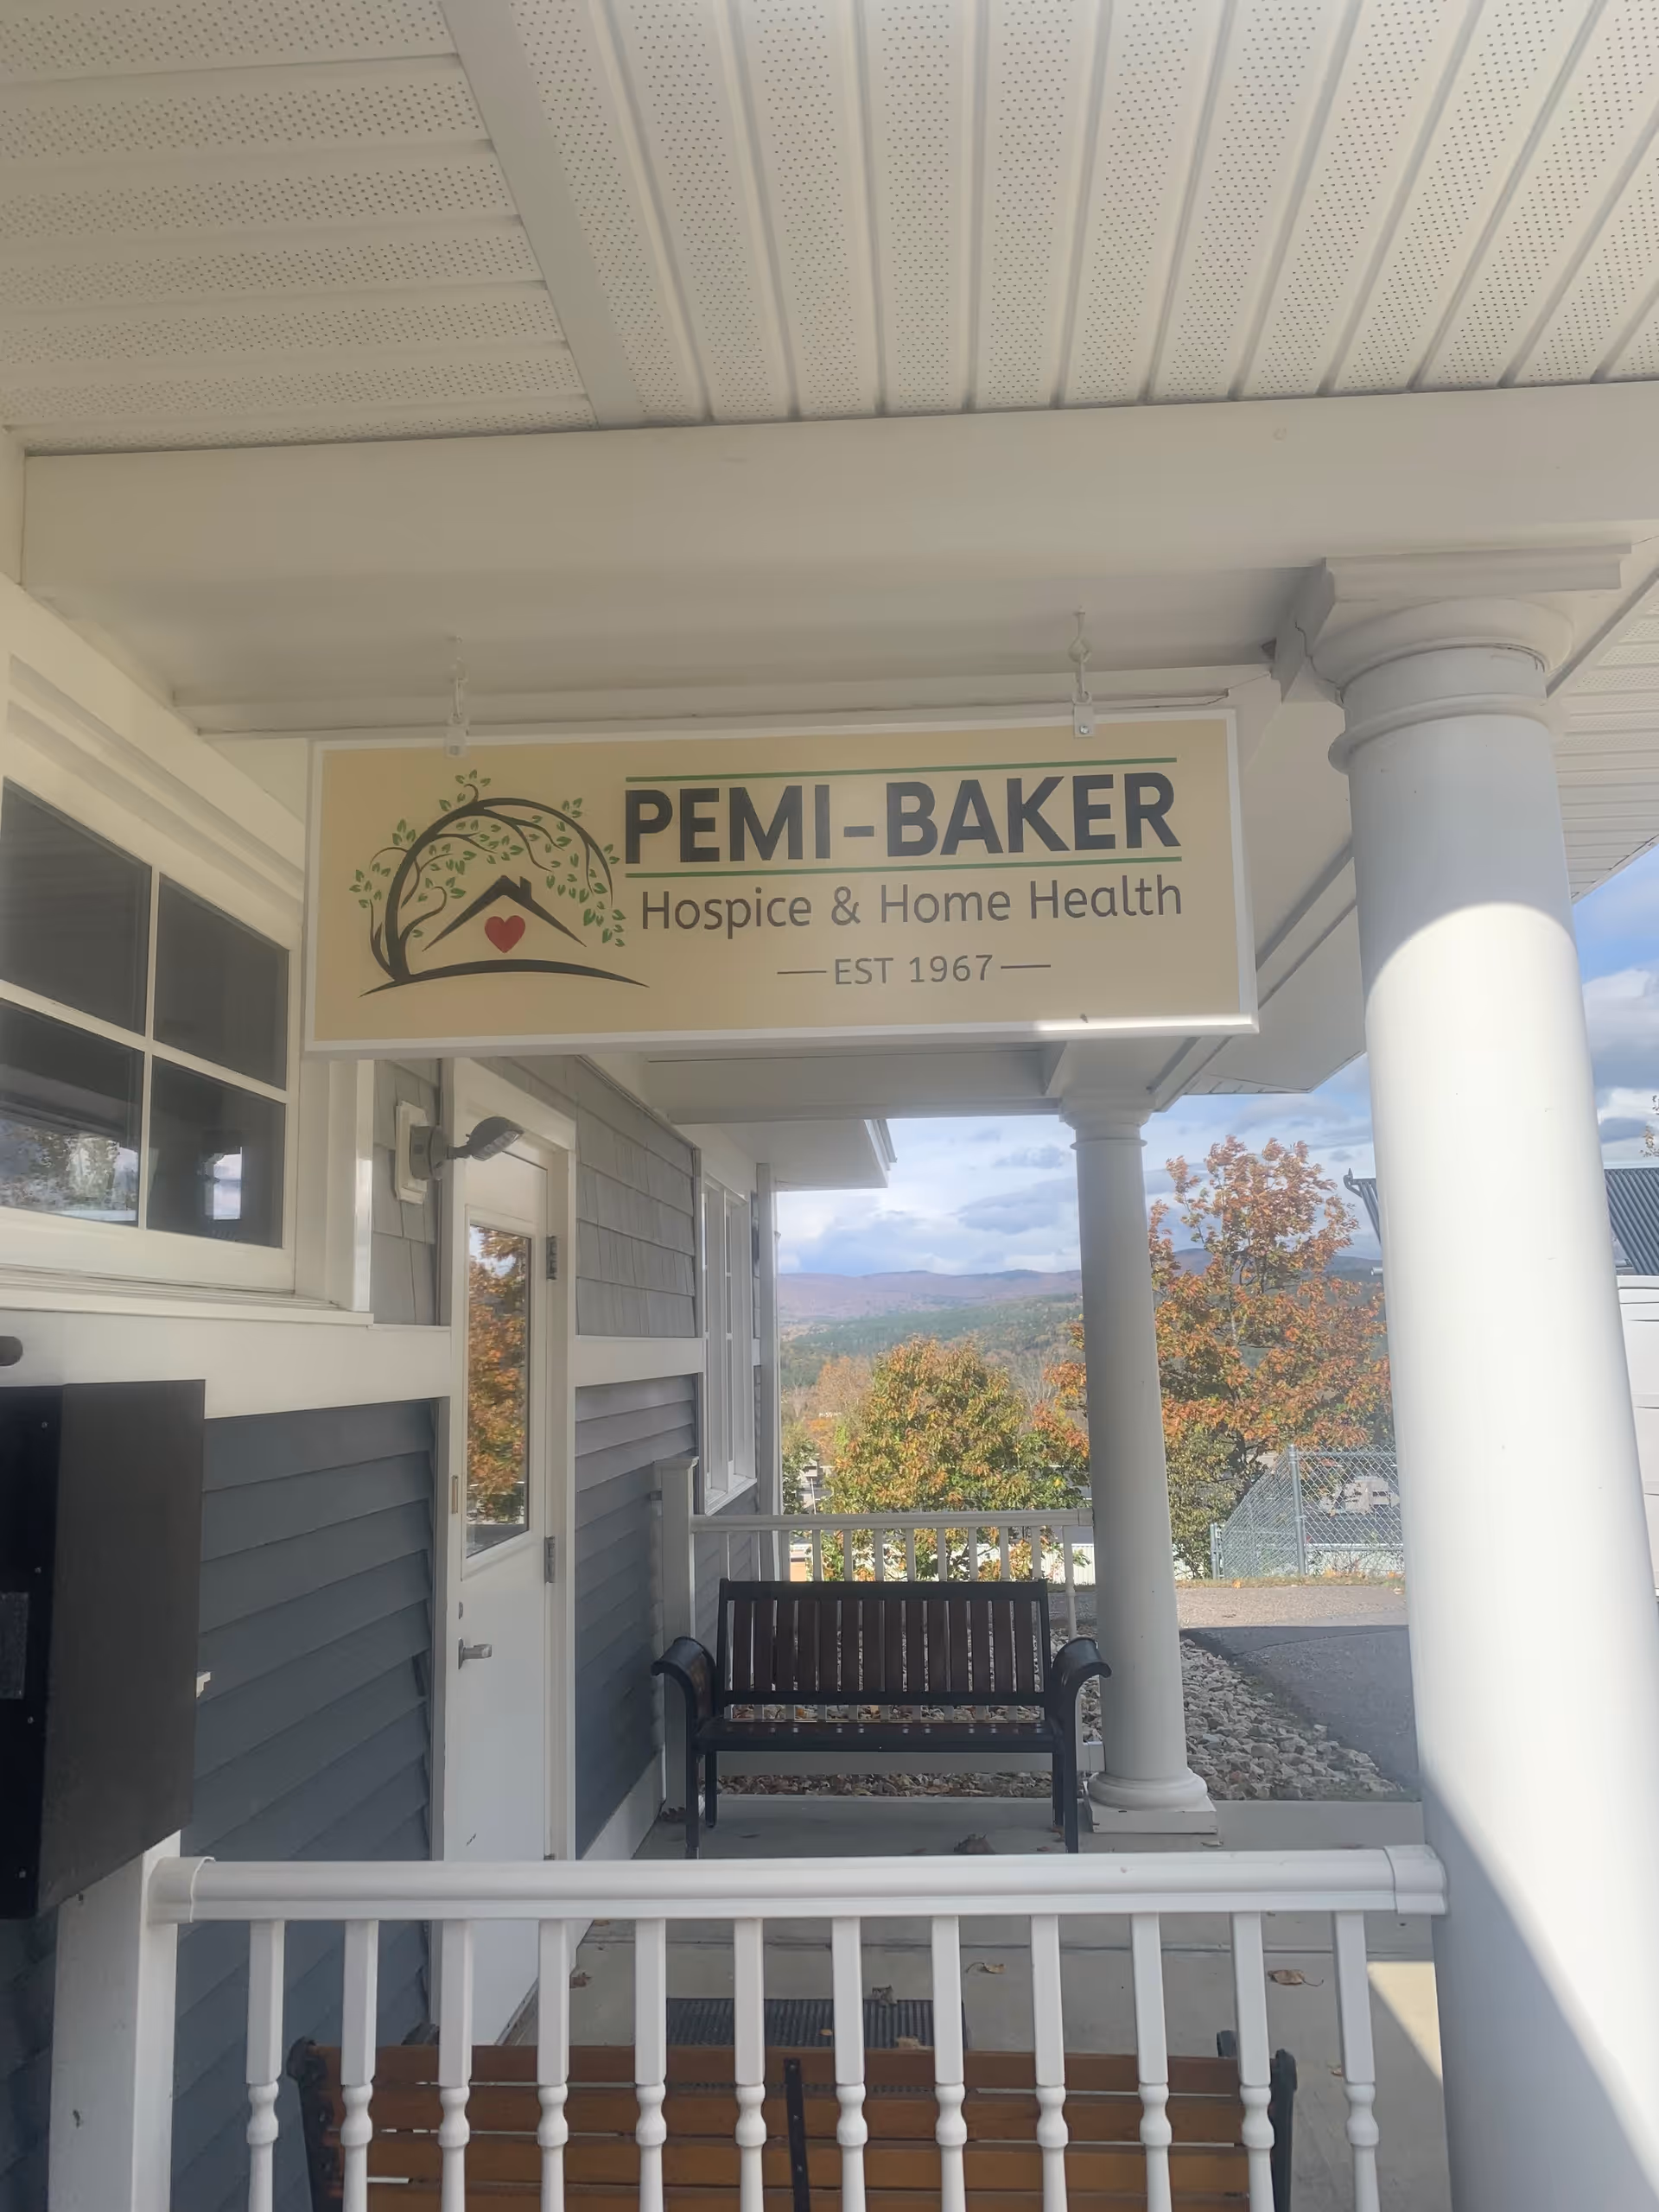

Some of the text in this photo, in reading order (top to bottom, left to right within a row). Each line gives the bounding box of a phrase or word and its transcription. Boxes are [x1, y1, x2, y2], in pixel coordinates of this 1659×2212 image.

[625, 772, 1182, 864] PEMI-BAKER
[642, 874, 1182, 939] Hospice & Home Health
[834, 954, 994, 985] EST 1967
